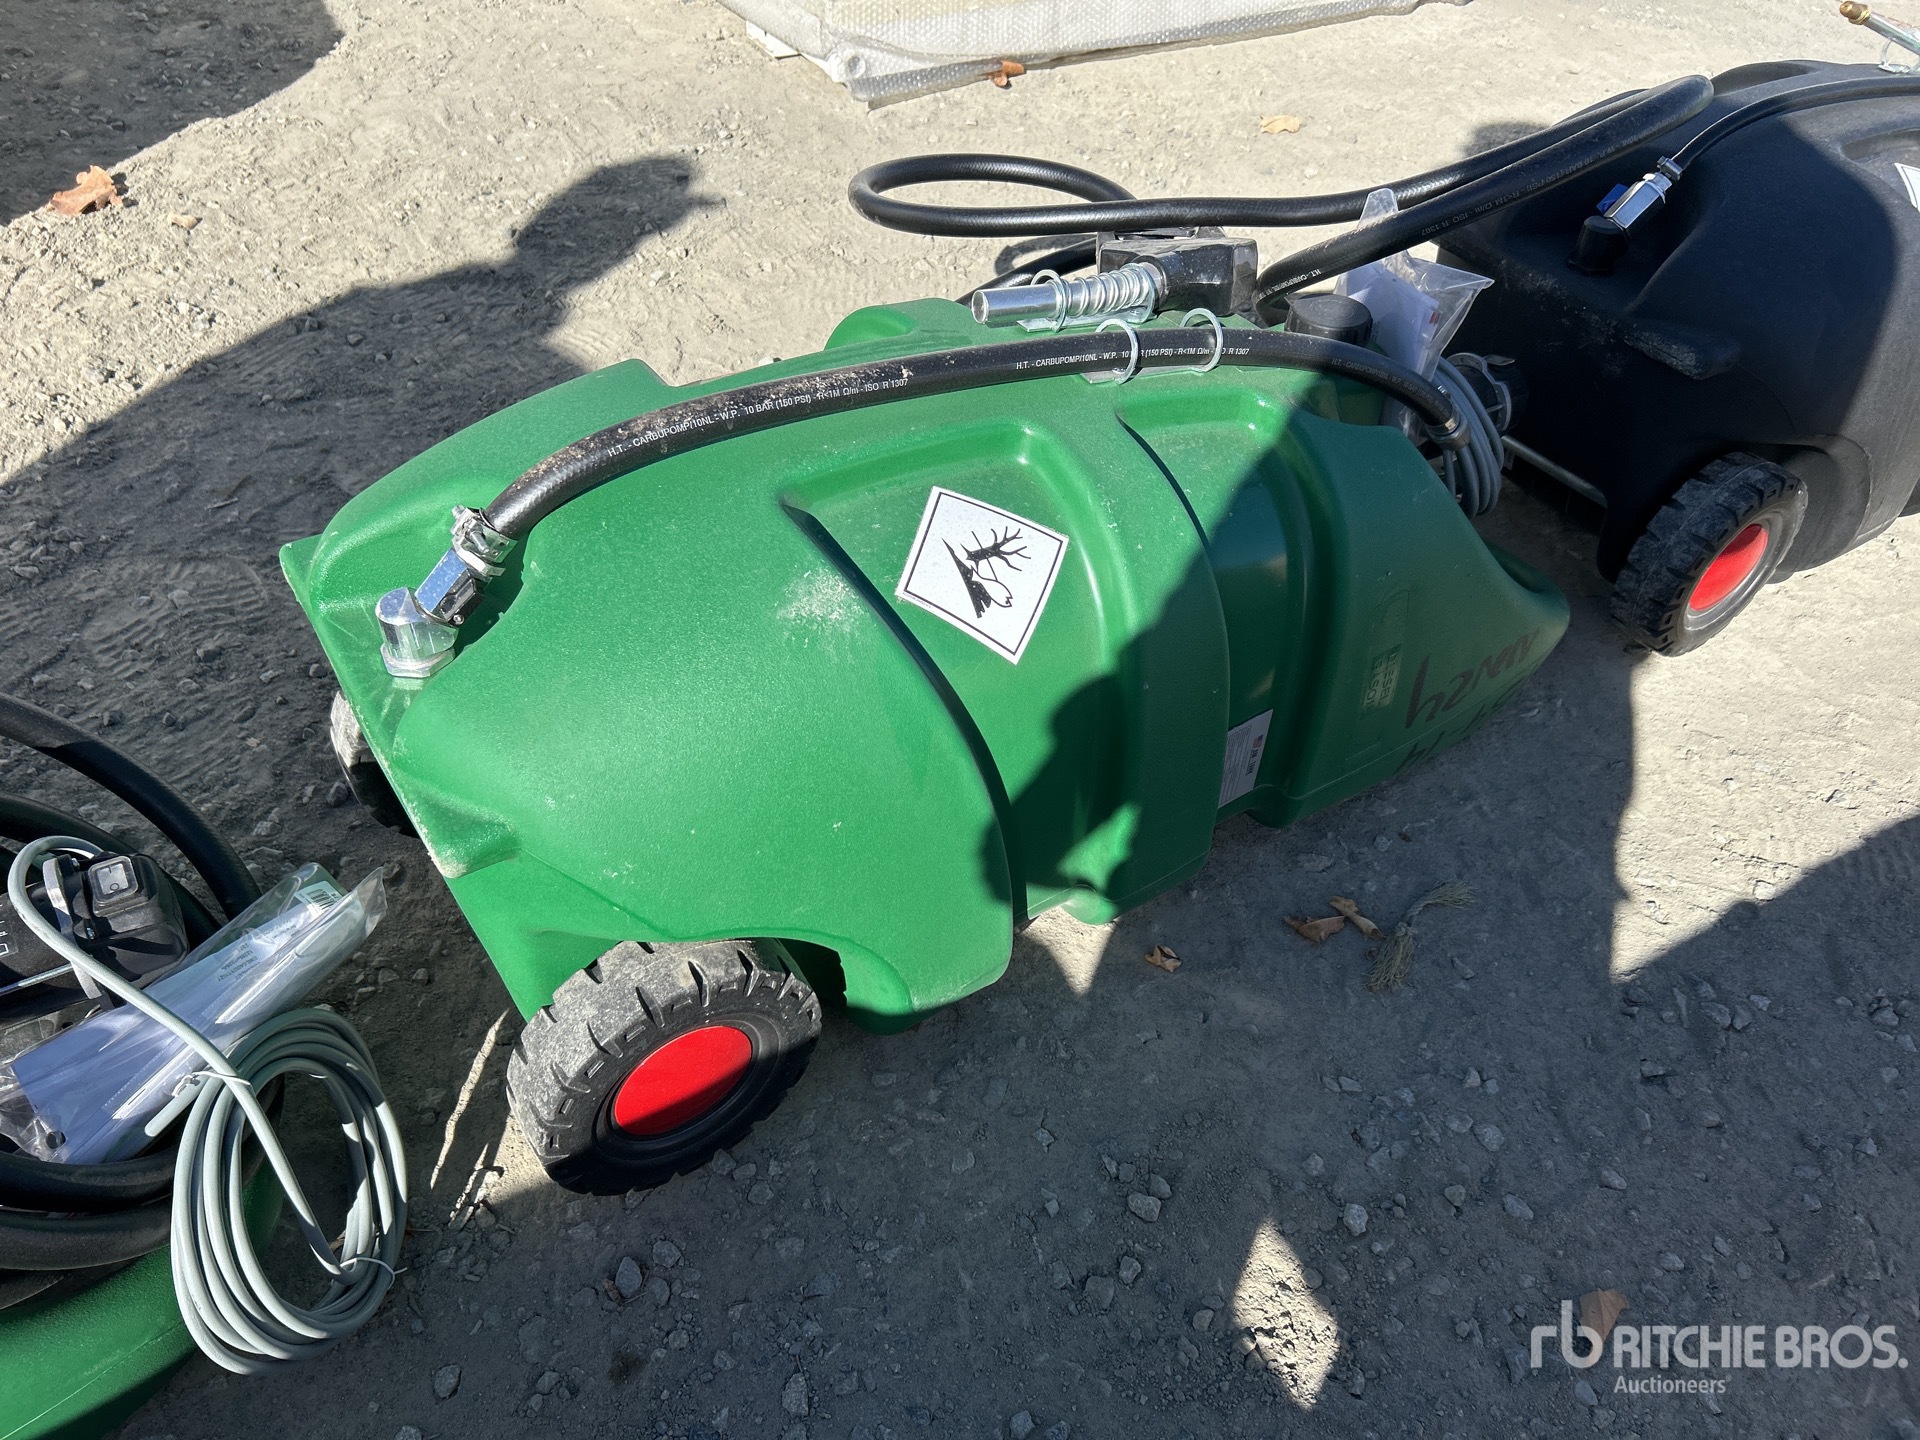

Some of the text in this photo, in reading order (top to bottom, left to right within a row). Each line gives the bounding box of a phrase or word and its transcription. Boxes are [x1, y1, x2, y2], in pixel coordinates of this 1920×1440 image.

[1016, 361, 1030, 370] H.T.
[1036, 353, 1098, 367] CARBUPOMP/10NL
[1103, 352, 1118, 360] W.P.
[1121, 350, 1130, 358] 10
[1145, 348, 1160, 358] (150
[1228, 347, 1234, 355] R
[1235, 347, 1250, 355] 1307
[607, 443, 627, 457] H.T.
[632, 416, 715, 447] CARBUPOMP/10NL
[720, 408, 741, 421] W.P.
[744, 406, 754, 415] 10
[756, 399, 775, 413] BAR
[776, 398, 794, 410] (150
[794, 393, 812, 405] PSI)
[818, 390, 841, 401] R<1M
[865, 383, 880, 393] ISO
[882, 381, 890, 389] R
[891, 378, 909, 388] 1307
